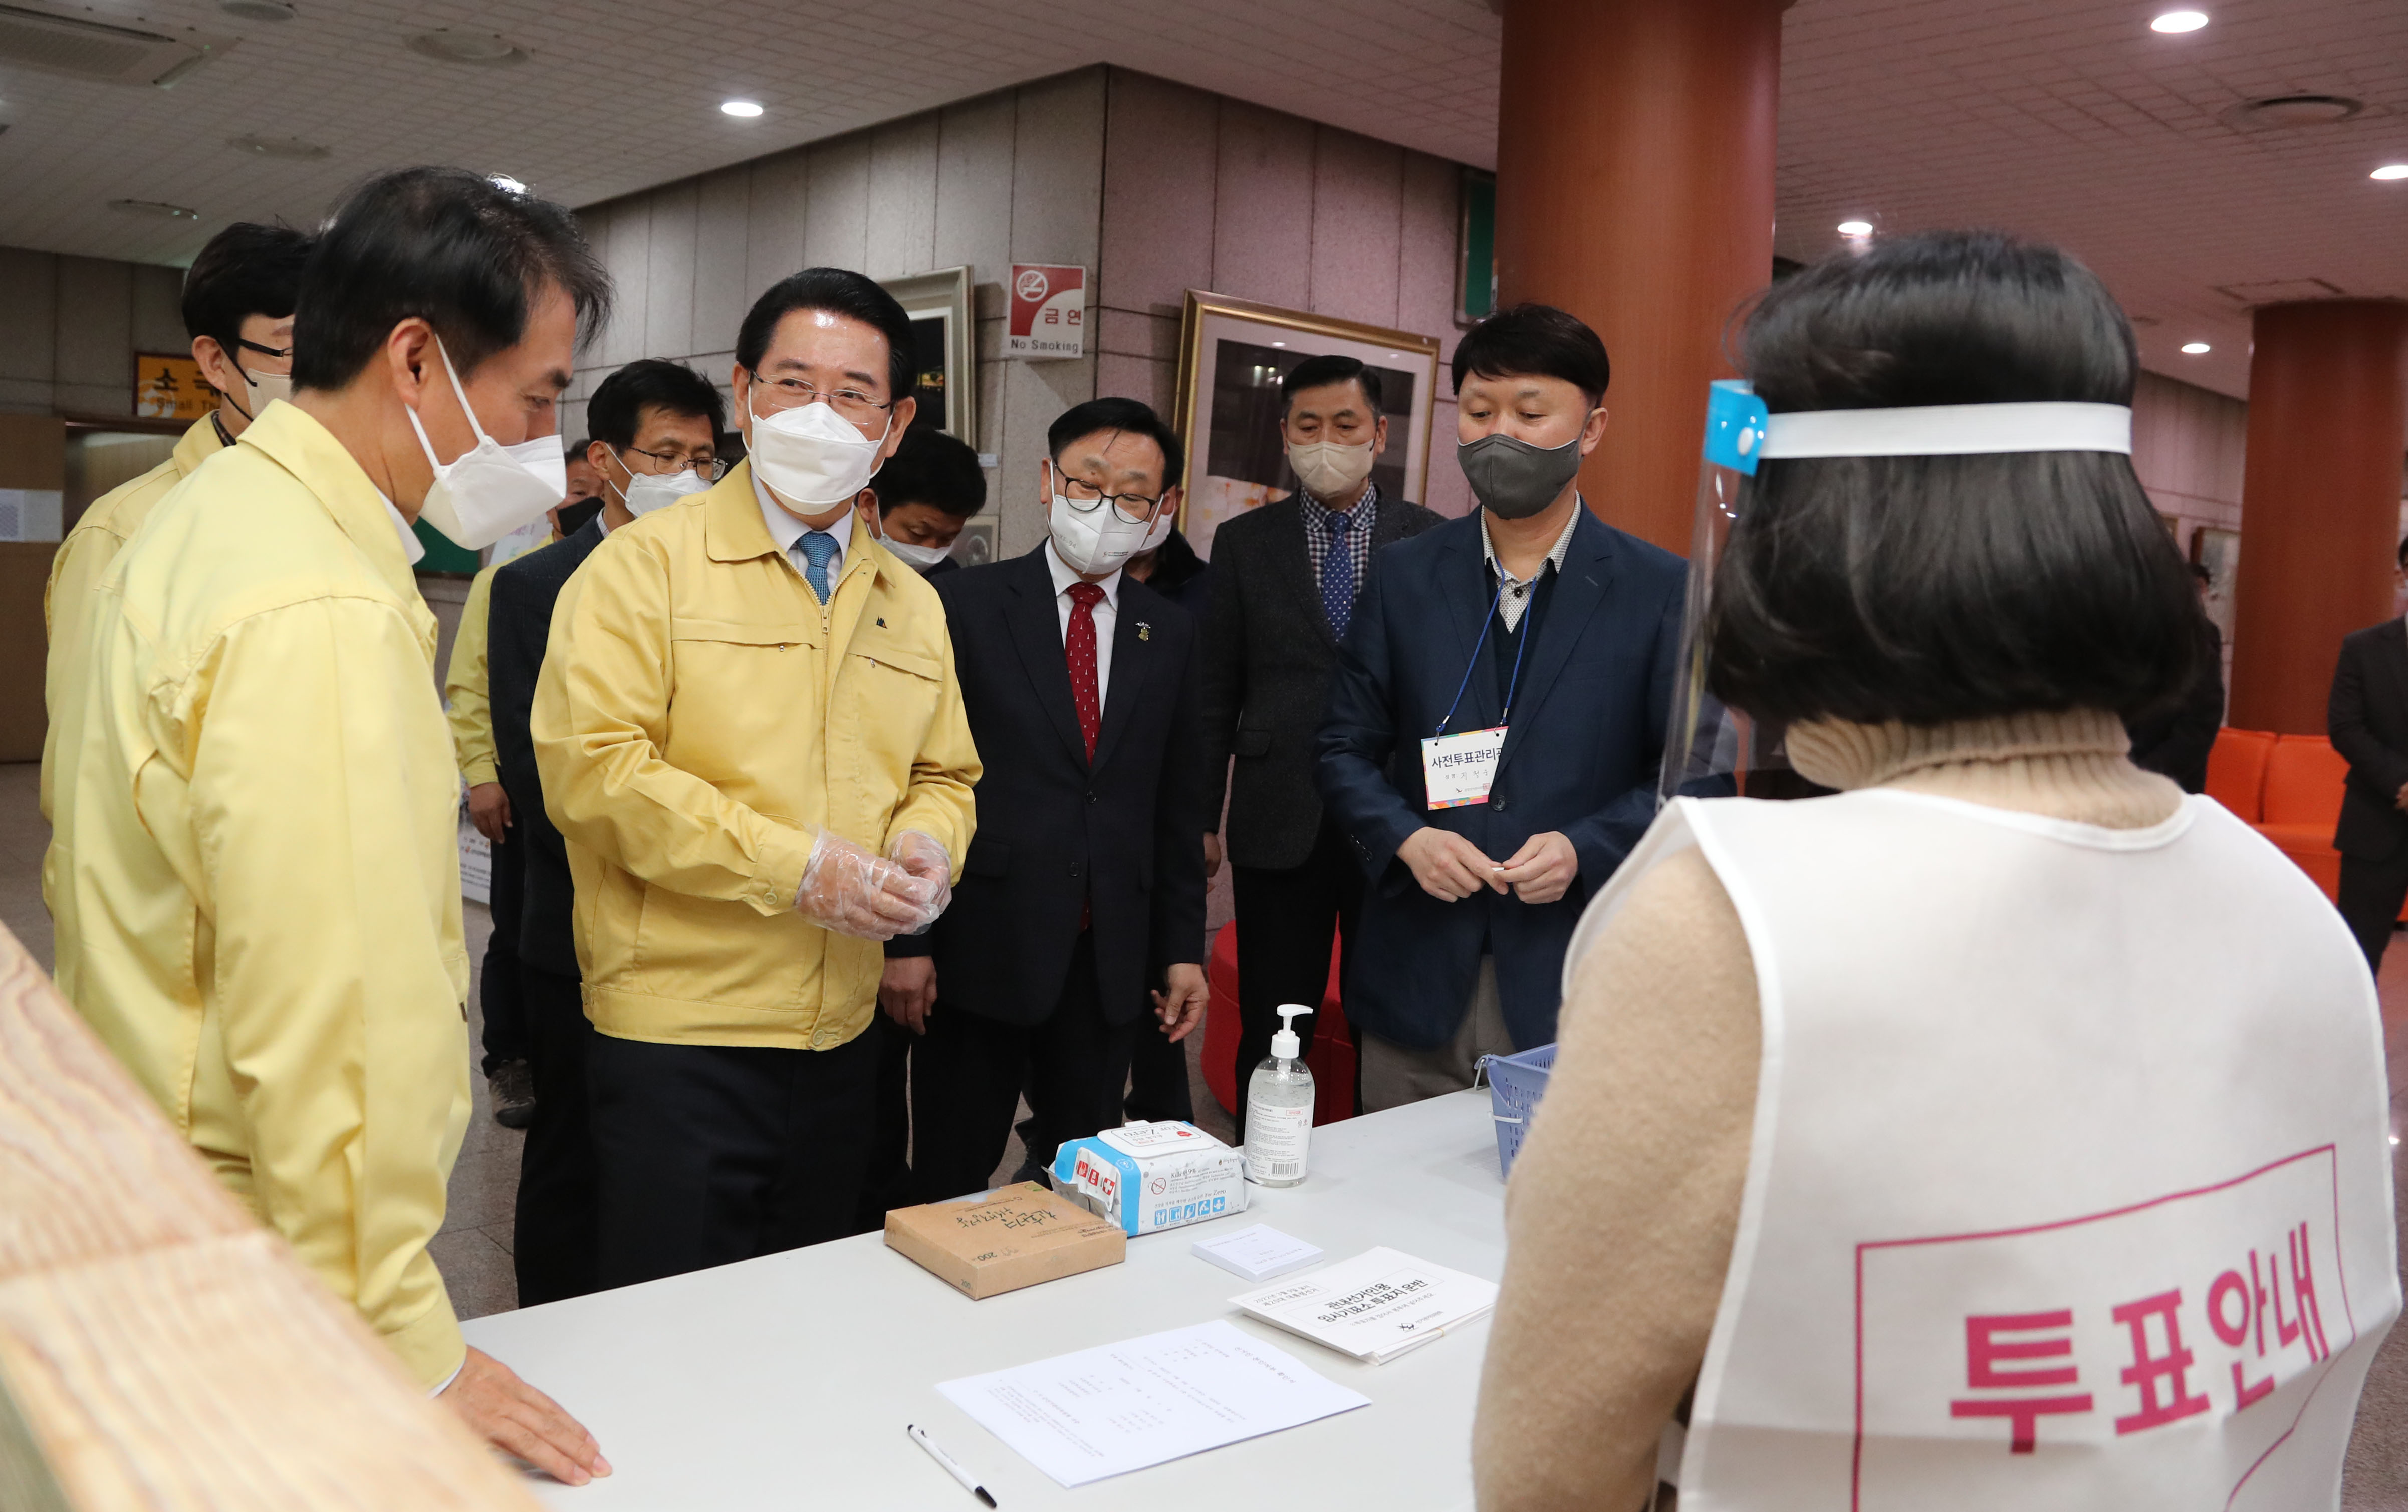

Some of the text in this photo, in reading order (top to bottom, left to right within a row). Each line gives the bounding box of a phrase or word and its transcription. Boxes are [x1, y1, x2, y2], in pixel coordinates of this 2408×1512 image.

[1045, 308, 1081, 325] 금연
[1011, 339, 1078, 354] No Smoking
[977, 1252, 998, 1262] 200
[960, 1279, 971, 1289] 200
[1317, 1279, 1428, 1322] 임시기표소 투표지 운반
[1325, 1283, 1391, 1309] 관내선거인용
[1950, 1221, 2329, 1454] 투표안내
